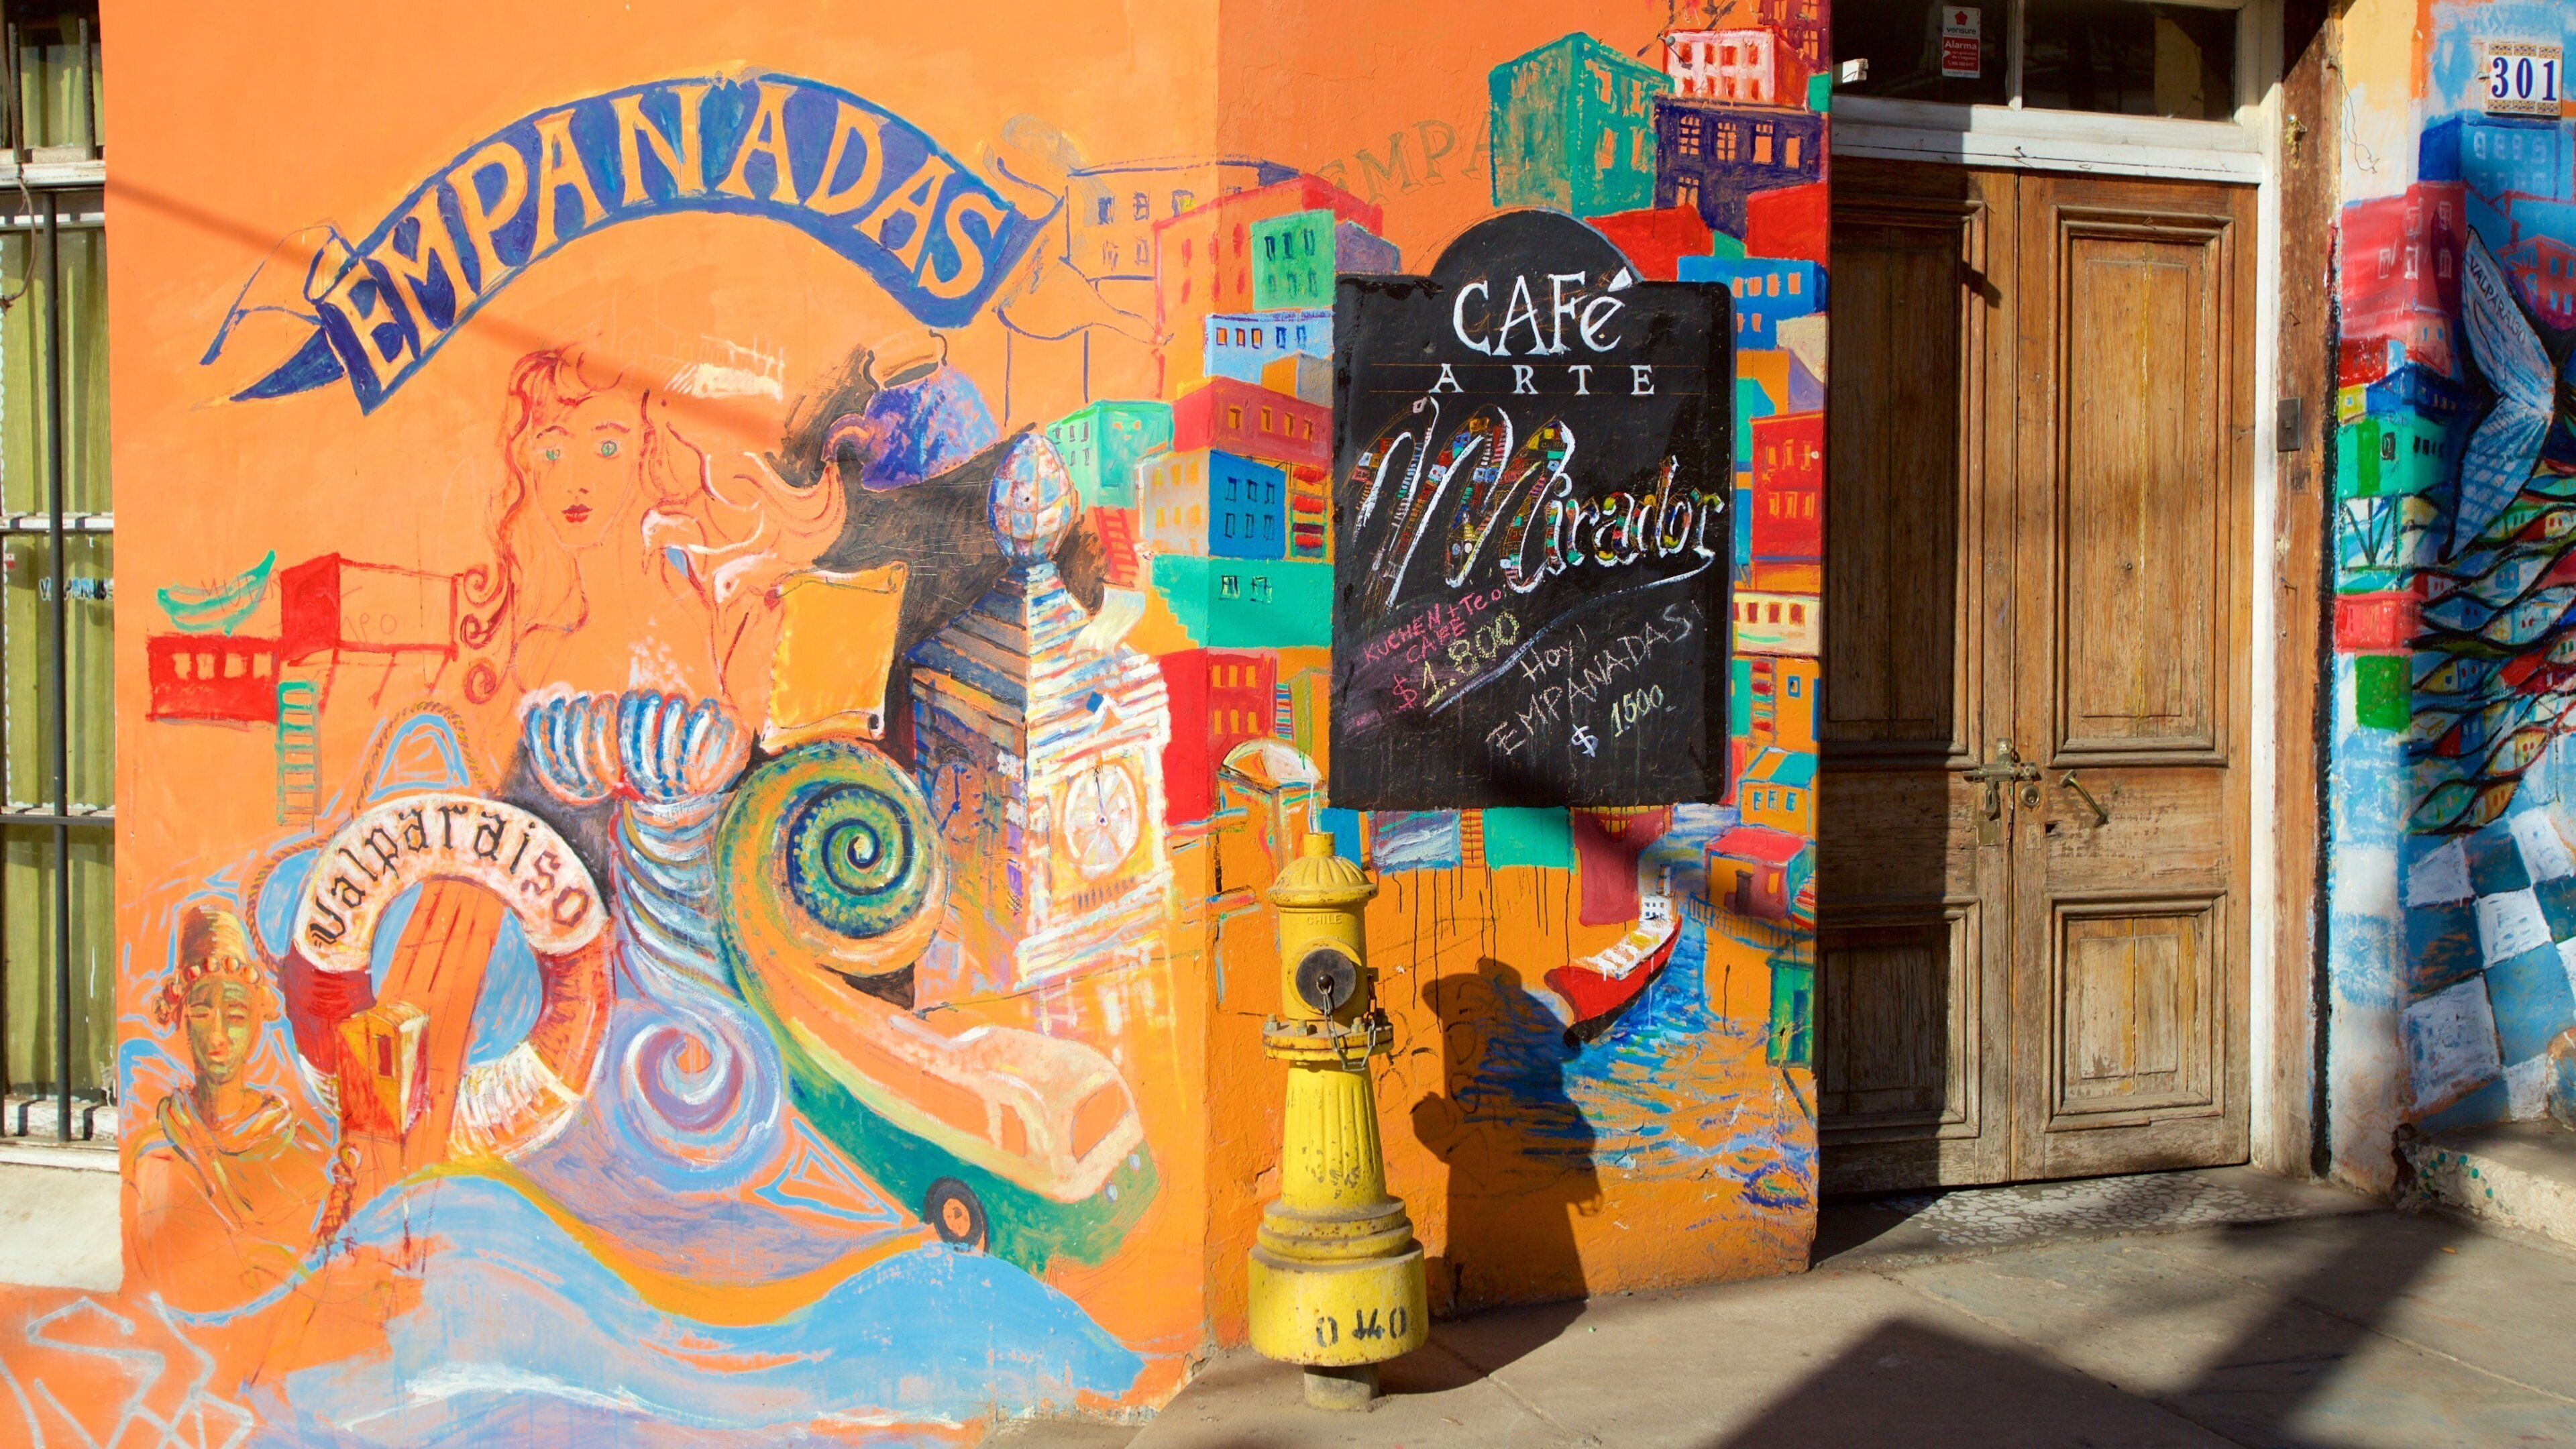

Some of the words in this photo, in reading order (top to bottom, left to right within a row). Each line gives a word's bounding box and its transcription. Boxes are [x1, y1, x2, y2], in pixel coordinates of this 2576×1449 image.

[1945, 40, 1977, 50] Alarma
[2491, 56, 2557, 101] 301
[322, 83, 1008, 394] EMPANADAS
[2469, 254, 2526, 344] VALPARAISO
[1428, 363, 1655, 396] ARTE
[1363, 603, 1442, 665] KUCHEN
[309, 804, 590, 948] Valparaiso
[1307, 914, 1342, 925] CHILE
